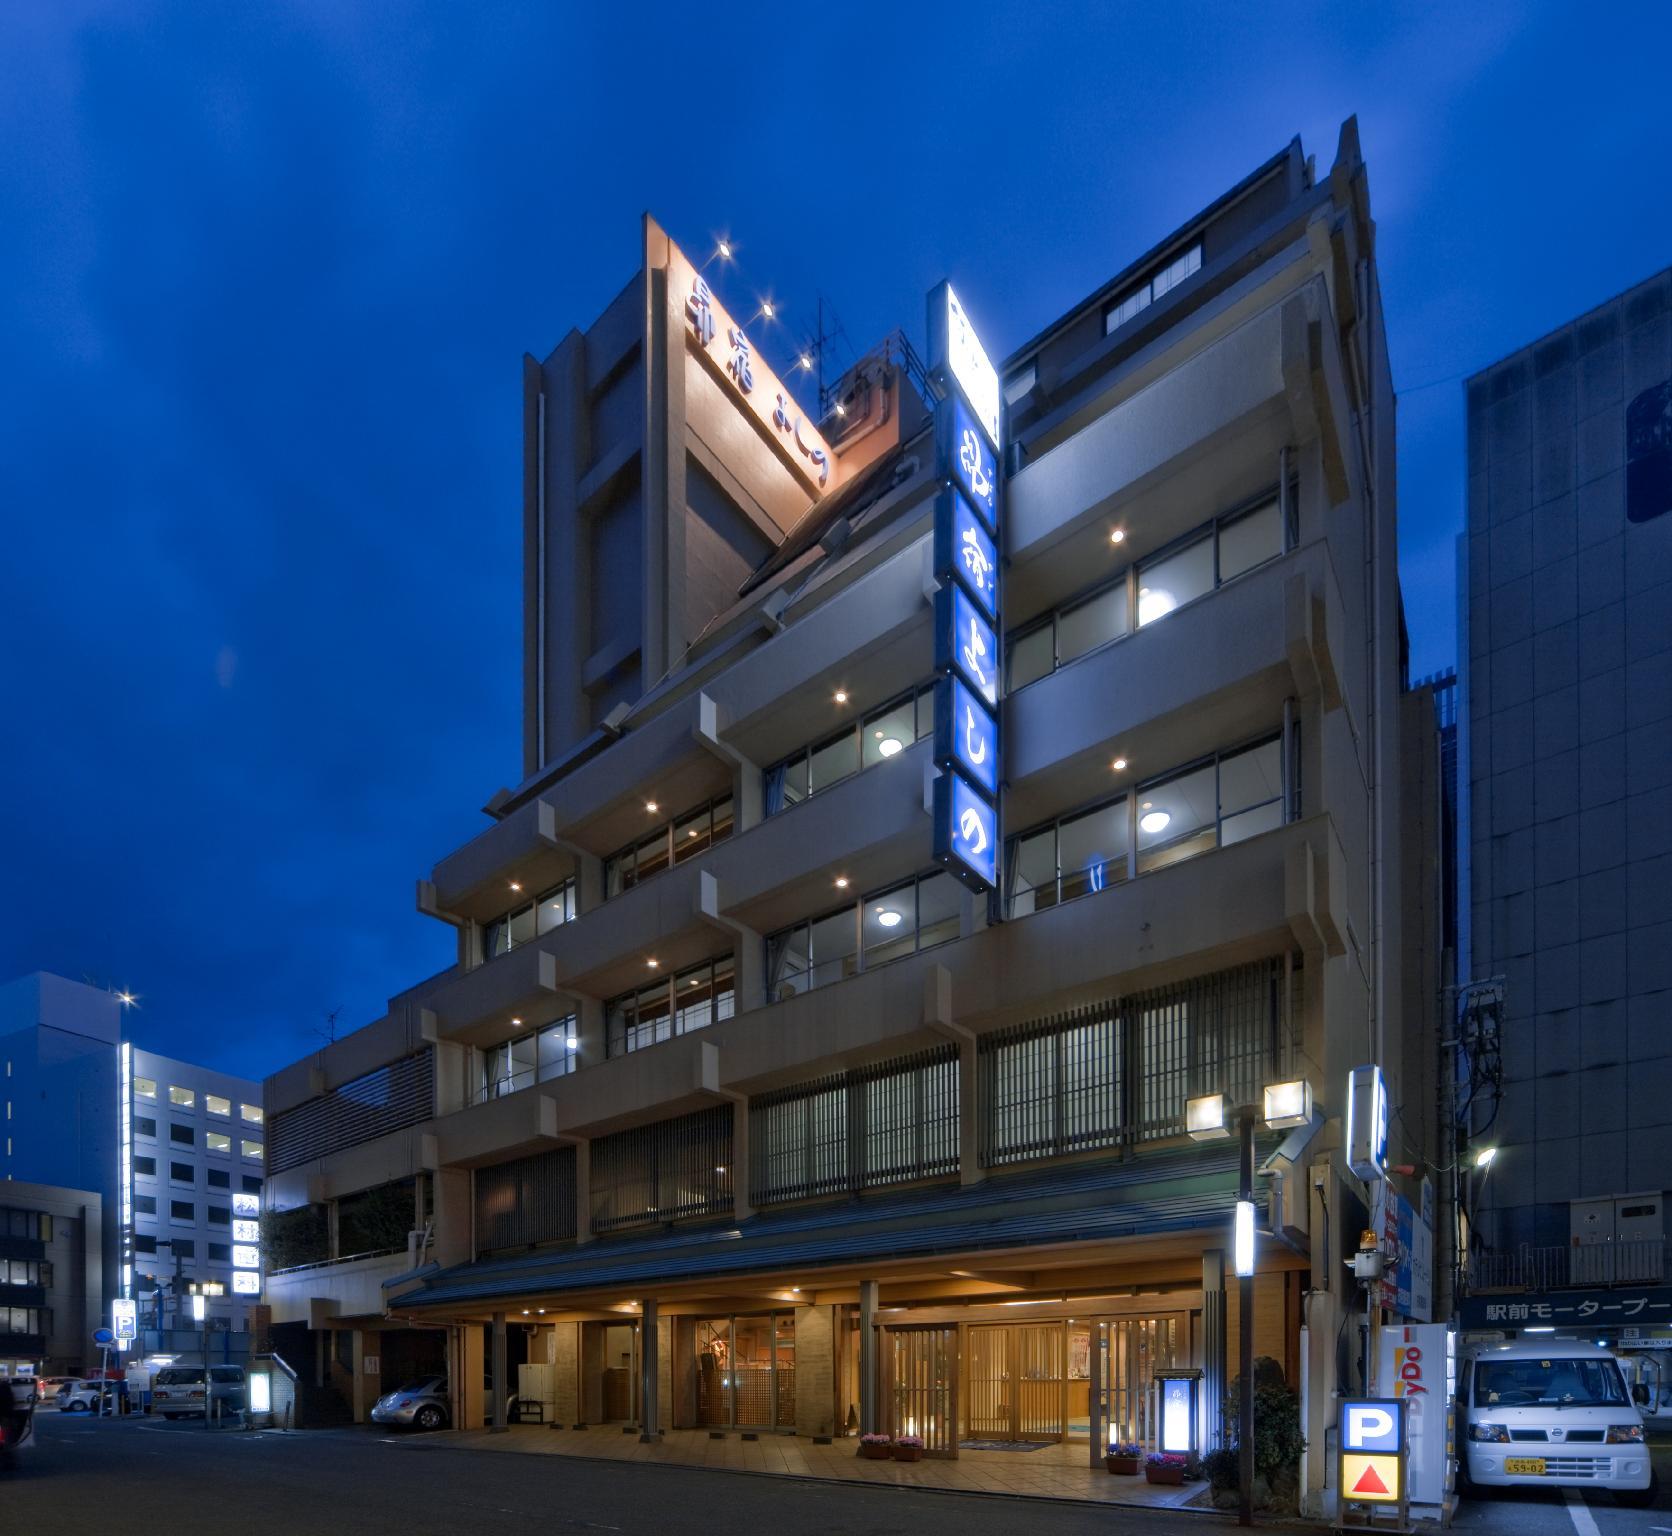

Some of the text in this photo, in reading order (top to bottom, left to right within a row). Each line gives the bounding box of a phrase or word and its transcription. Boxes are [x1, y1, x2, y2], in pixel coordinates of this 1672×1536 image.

[1486, 1297, 1672, 1320] 駅前モータープー
[118, 1316, 132, 1330] P
[1349, 1408, 1393, 1447] P
